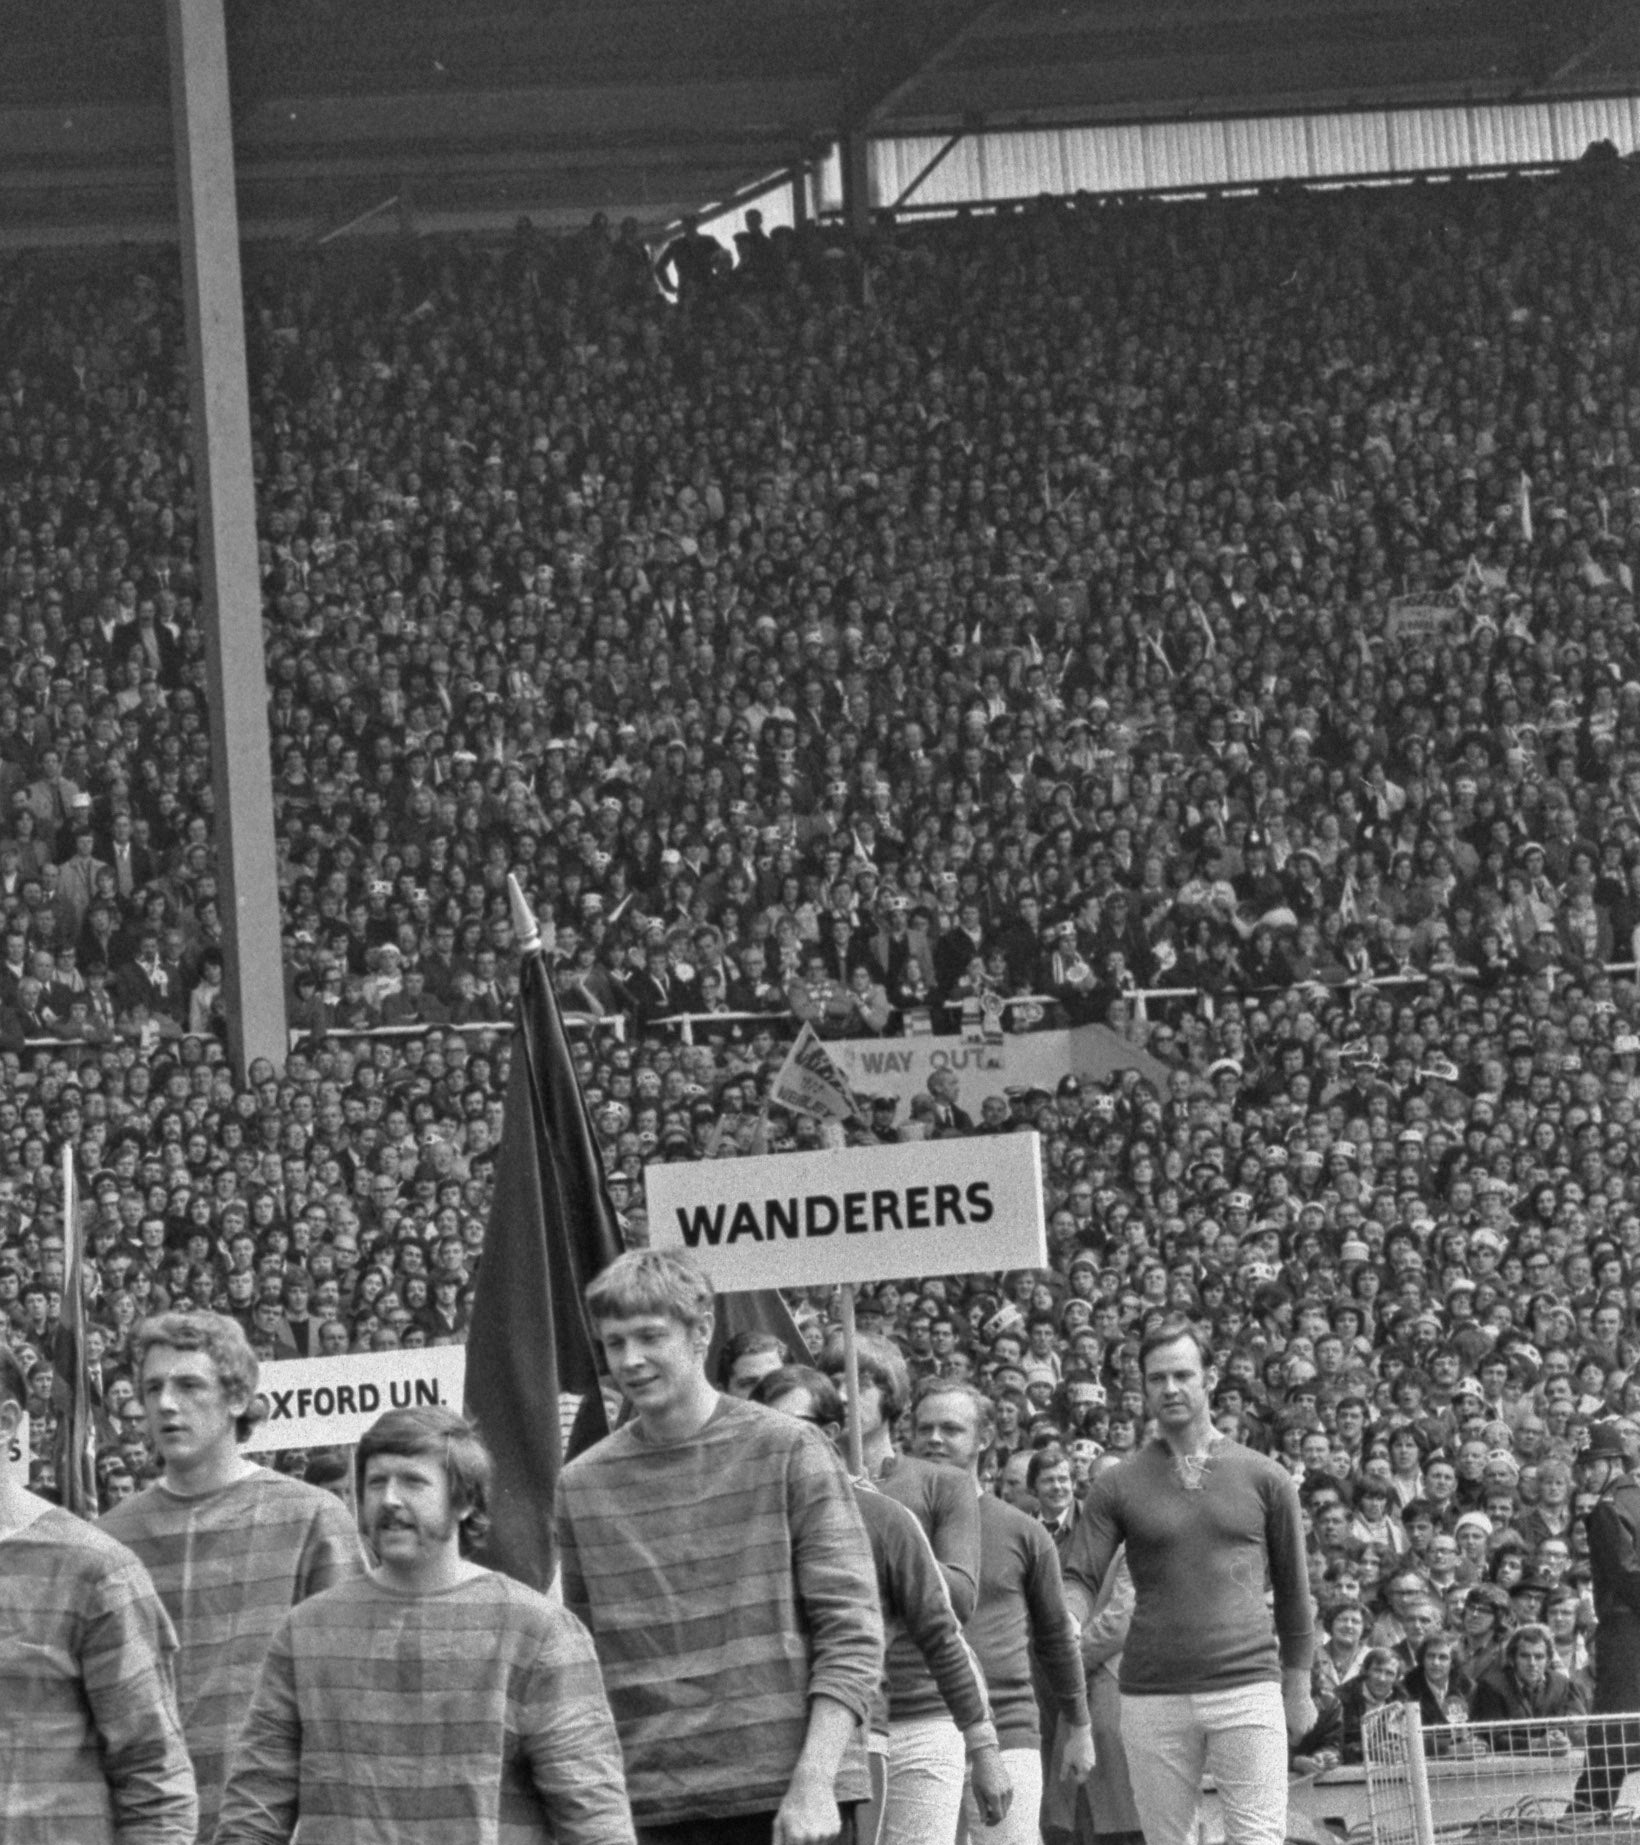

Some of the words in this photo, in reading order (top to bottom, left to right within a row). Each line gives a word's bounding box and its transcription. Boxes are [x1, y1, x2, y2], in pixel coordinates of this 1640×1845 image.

[861, 1051, 913, 1074] WAY
[930, 1048, 984, 1071] OUT
[676, 1182, 994, 1247] WANDERERS
[390, 1378, 447, 1408] UN.
